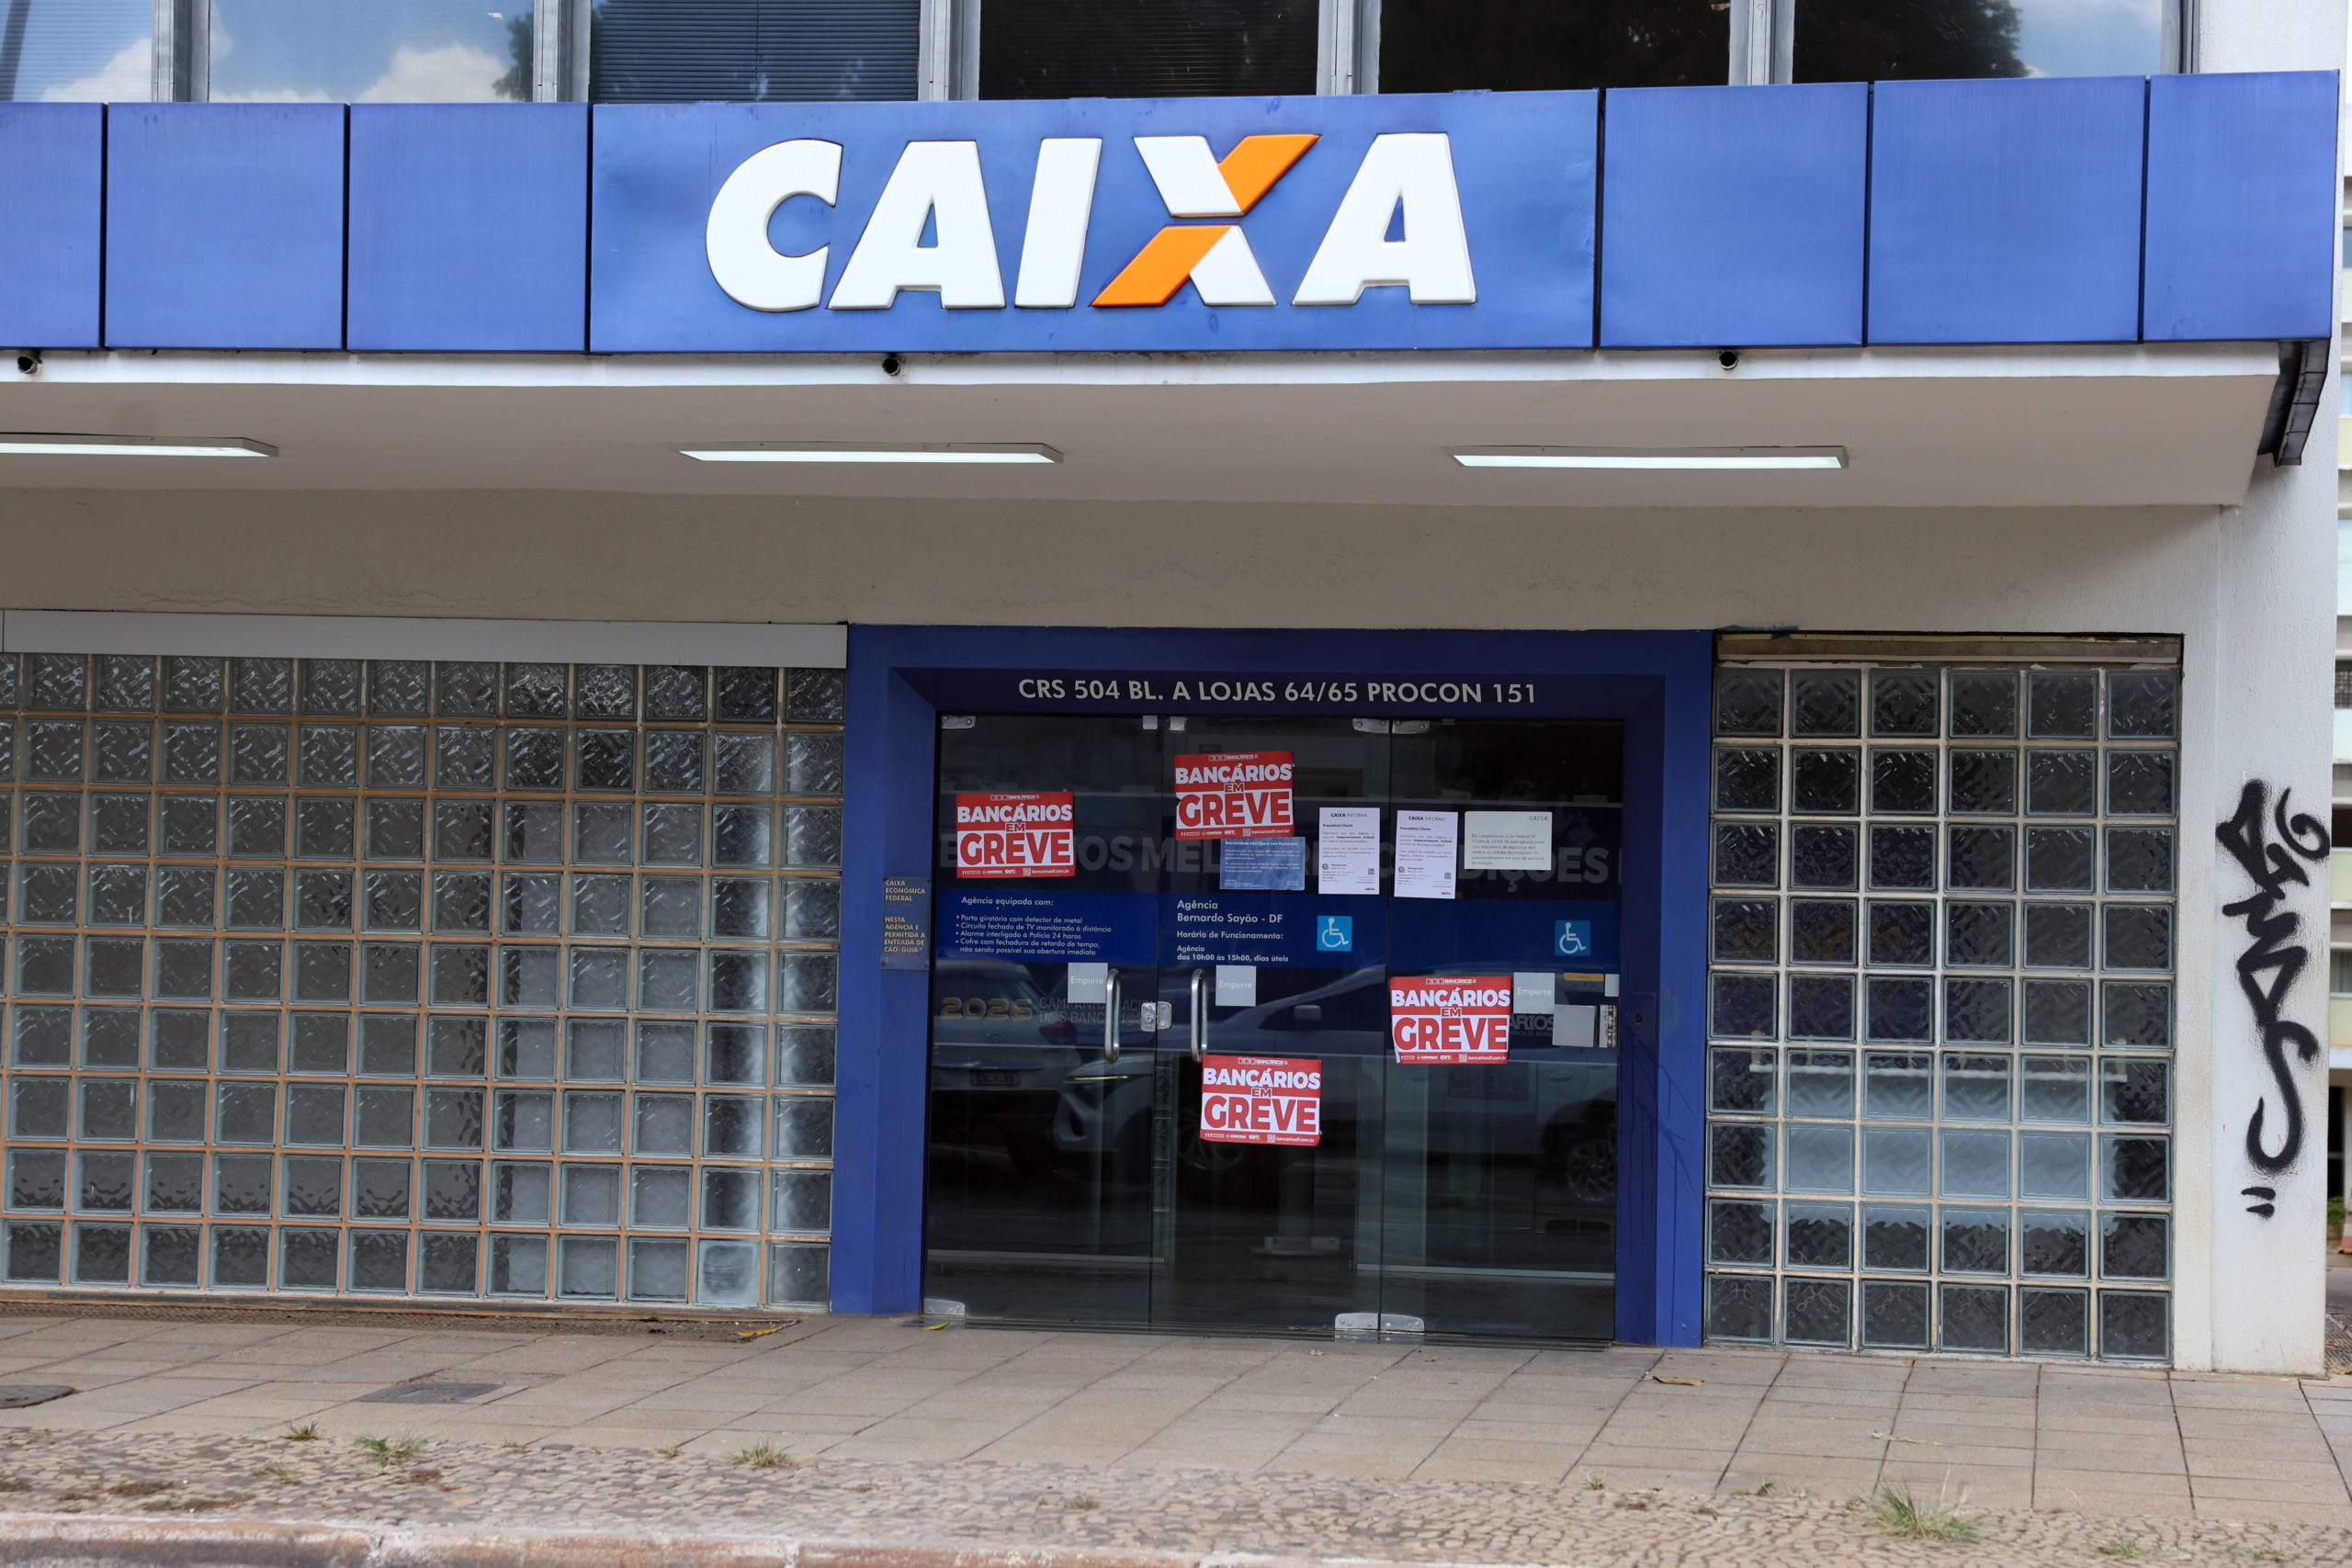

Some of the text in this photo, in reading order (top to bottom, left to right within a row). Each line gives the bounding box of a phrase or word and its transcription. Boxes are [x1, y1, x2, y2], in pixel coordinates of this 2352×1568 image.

[706, 132, 1477, 312] CAIXA
[1018, 679, 1535, 703] CRS 504 BL. A LOJAS 64/65 PROCON 151
[1176, 763, 1292, 784] BANCÁRIOS
[1225, 784, 1244, 792] EM
[957, 803, 1073, 823] BANCÁRIOS
[1179, 791, 1290, 827] GREVE
[1006, 823, 1025, 832] EM
[960, 832, 1070, 865] GREVE
[961, 897, 993, 905] Agência
[995, 897, 1032, 907] equipada
[1177, 900, 1218, 910] Agência
[1177, 913, 1224, 922] Bernardo
[1227, 914, 1258, 924] Sayão
[1269, 914, 1283, 923] DF
[986, 931, 1021, 939] interligado
[1221, 931, 1283, 940] Funcionamento:
[1070, 976, 1104, 985] Empurre
[1219, 980, 1253, 990] Empurre
[1517, 987, 1551, 996] Empurre
[1391, 988, 1510, 1007] BANCÁRIOS
[939, 997, 1034, 1021] 2026
[1441, 1008, 1461, 1017] EM
[1394, 1017, 1507, 1050] GREVE
[1203, 1067, 1320, 1090] BANCÁRIOS
[1252, 1088, 1271, 1097] EM
[1204, 1095, 1316, 1132] GREVE
